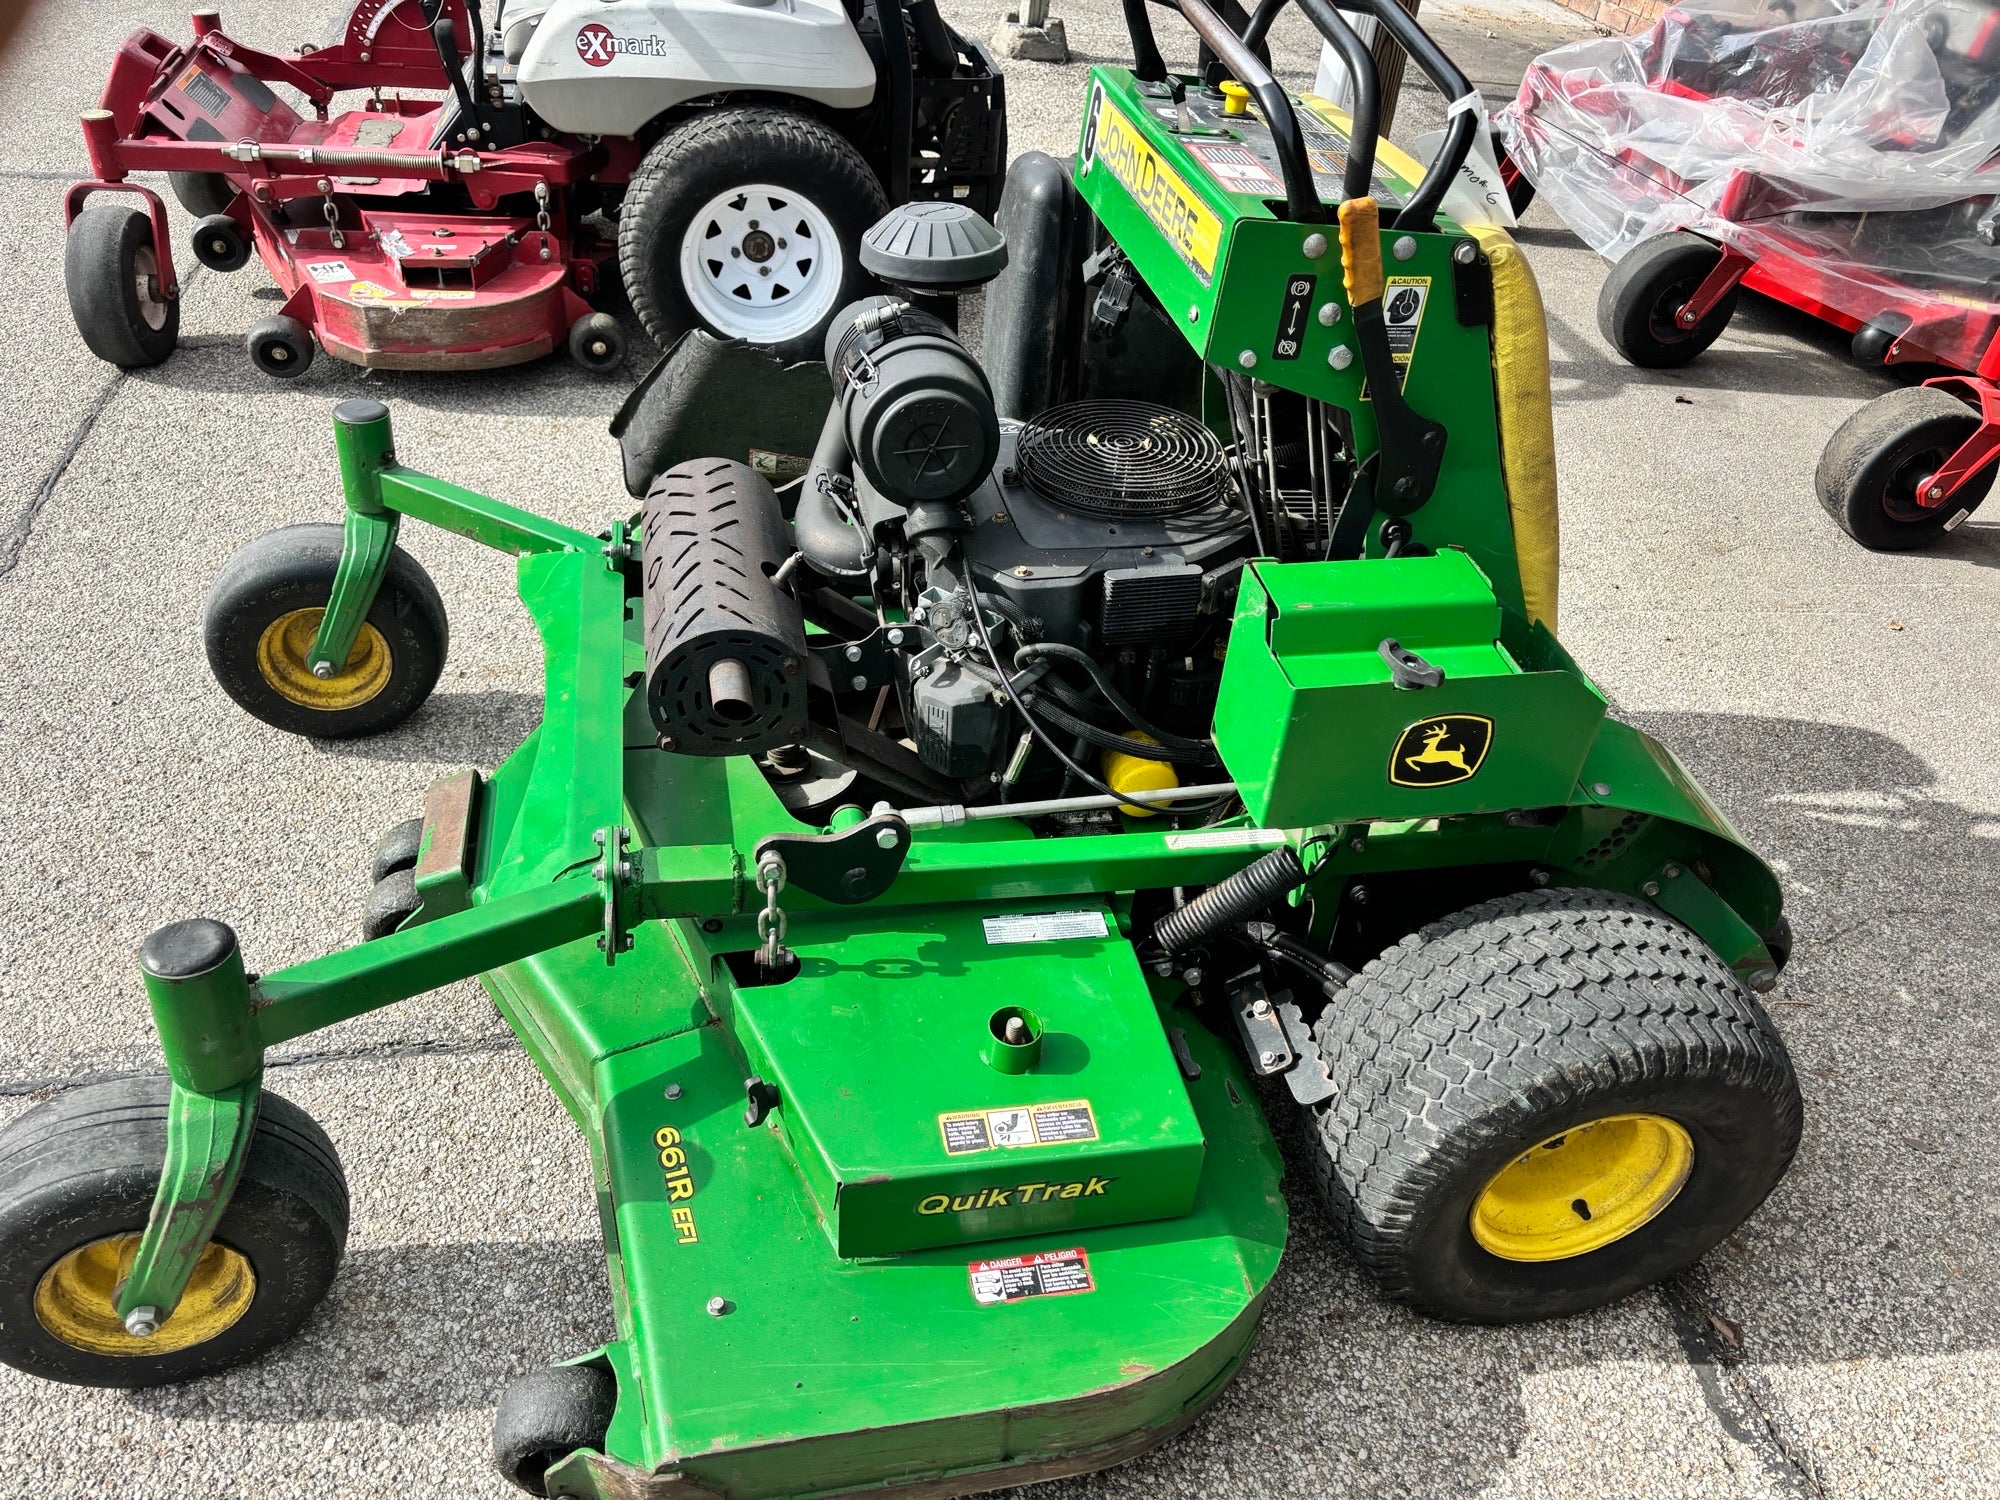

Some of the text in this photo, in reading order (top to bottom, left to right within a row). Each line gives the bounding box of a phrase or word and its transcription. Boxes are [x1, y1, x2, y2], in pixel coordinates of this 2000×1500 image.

[1085, 86, 1102, 162] 6
[1100, 111, 1199, 240] JOHN DEERE
[656, 1126, 699, 1244] 661R EFI
[989, 1257, 1023, 1269] DANGER
[1044, 1249, 1078, 1261] PELIGRO
